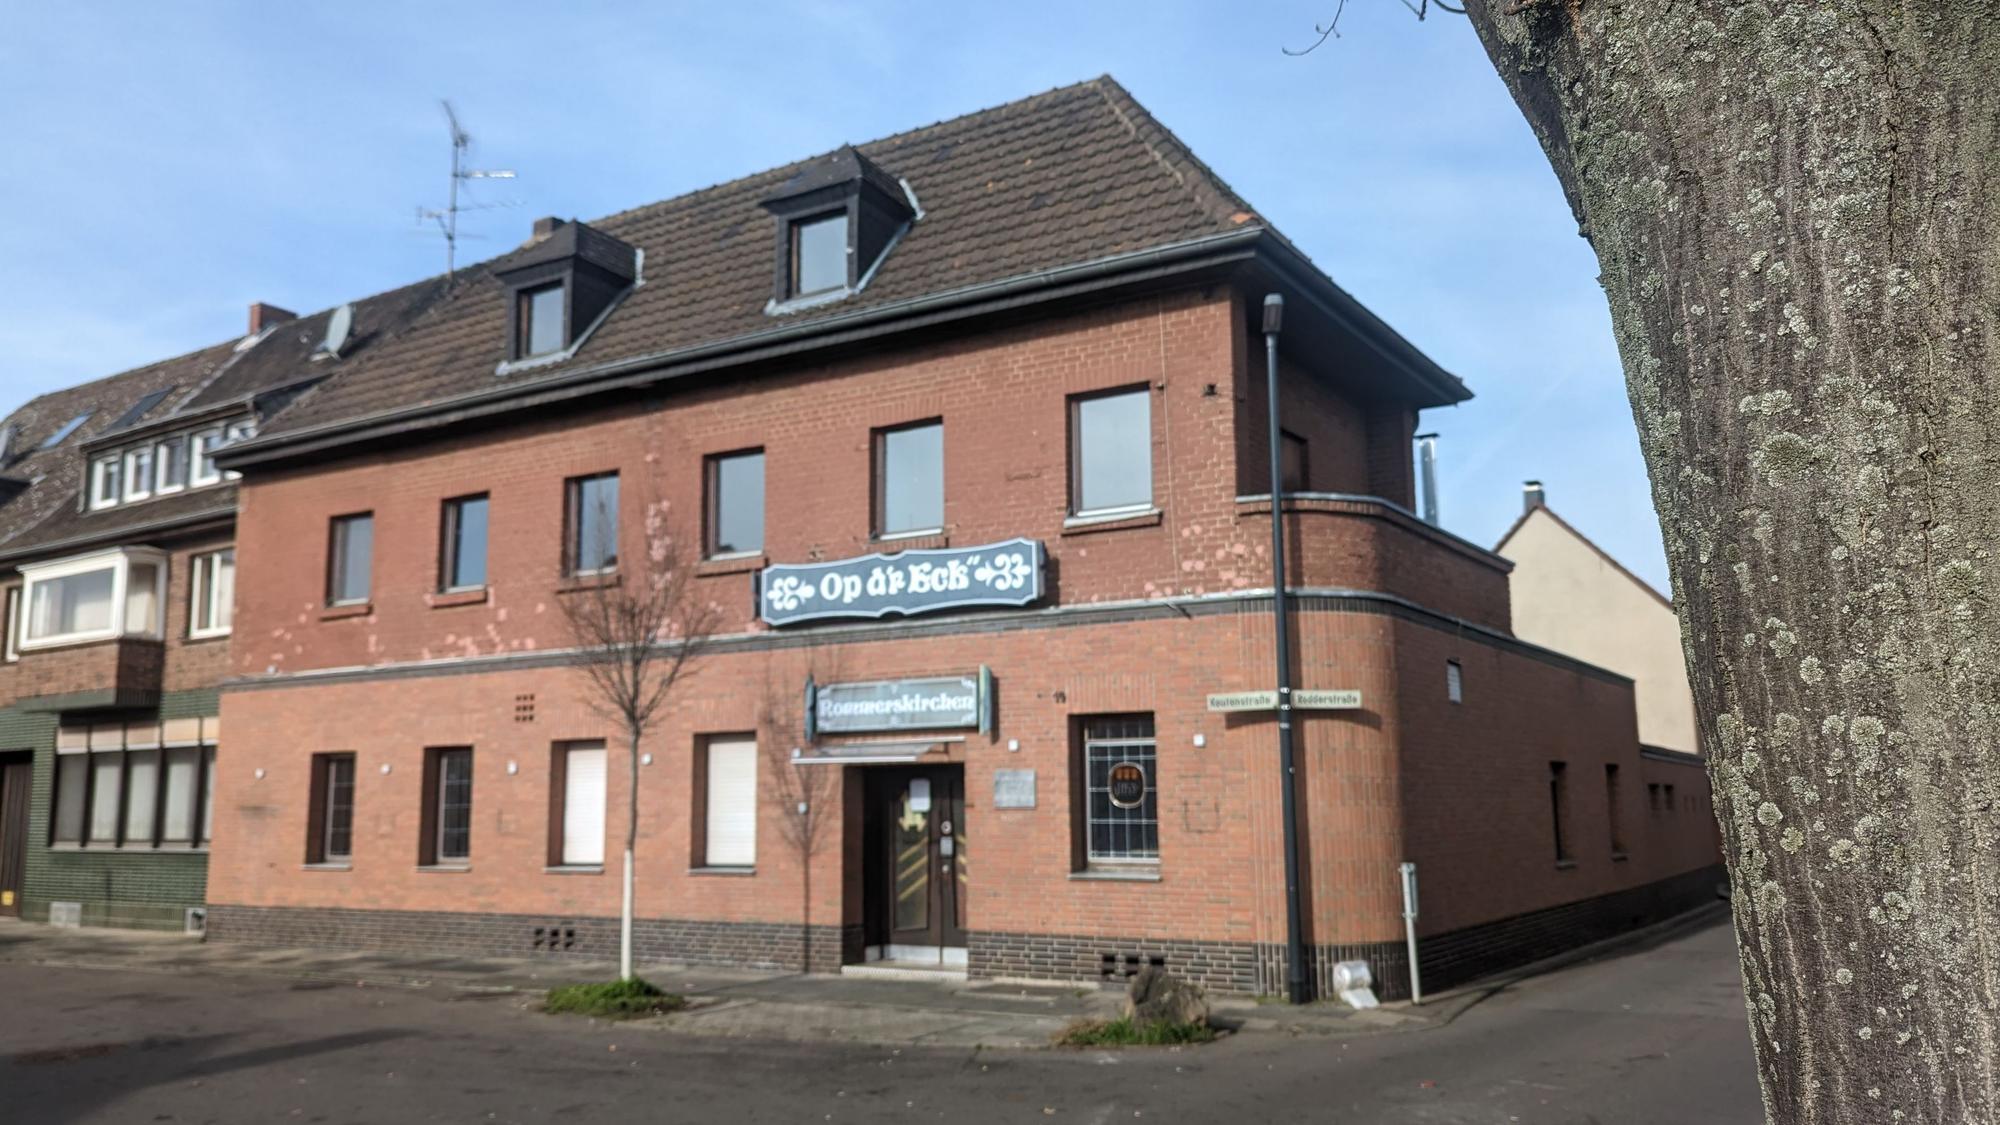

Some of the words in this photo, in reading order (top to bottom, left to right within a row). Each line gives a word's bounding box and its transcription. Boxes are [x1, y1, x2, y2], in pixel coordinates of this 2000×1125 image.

[820, 572, 862, 603] Op
[866, 565, 906, 597] d'r
[819, 693, 974, 718] Rommerskirchen
